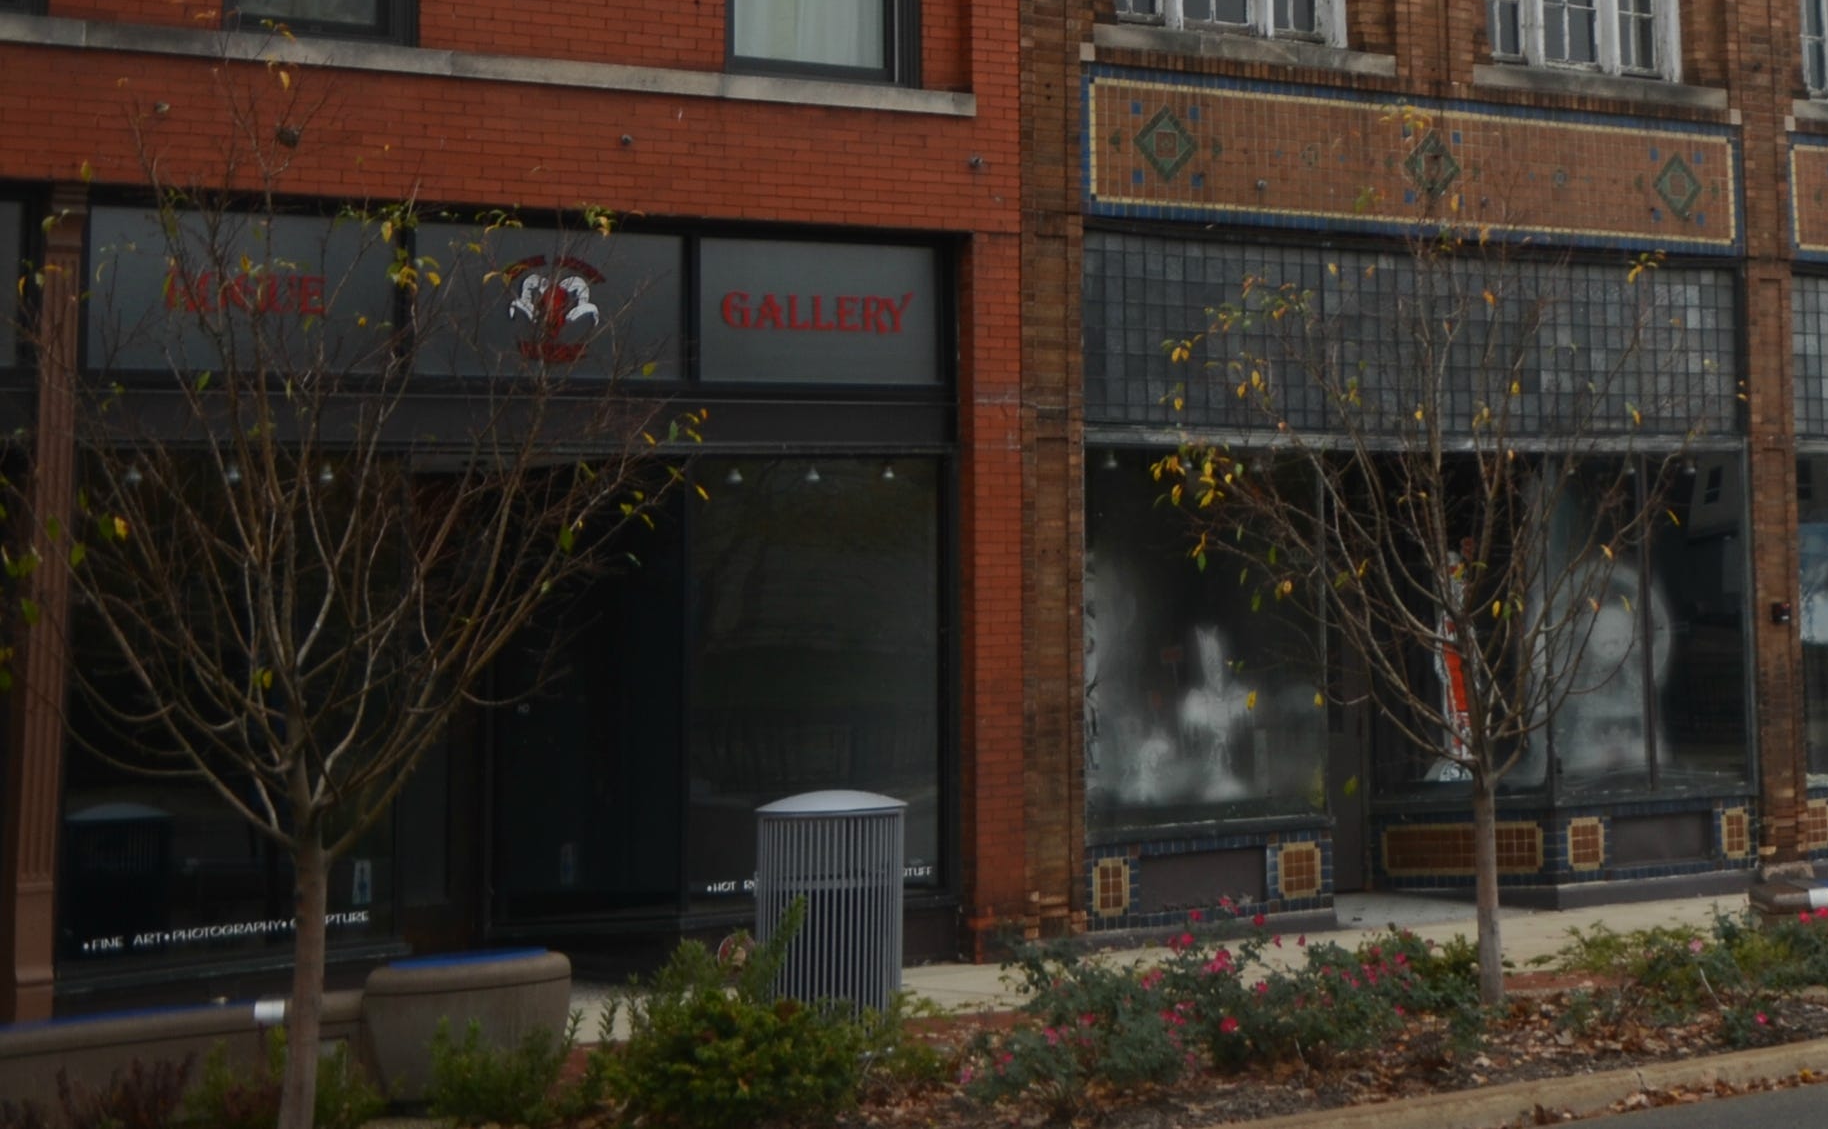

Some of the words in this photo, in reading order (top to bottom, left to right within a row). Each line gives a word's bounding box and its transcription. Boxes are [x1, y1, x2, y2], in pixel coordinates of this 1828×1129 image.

[721, 290, 914, 334] GALLERY
[713, 879, 737, 892] HOT
[91, 935, 125, 953] FINE
[133, 932, 163, 946] ART
[171, 919, 282, 942] PHOTOGRAPHY
